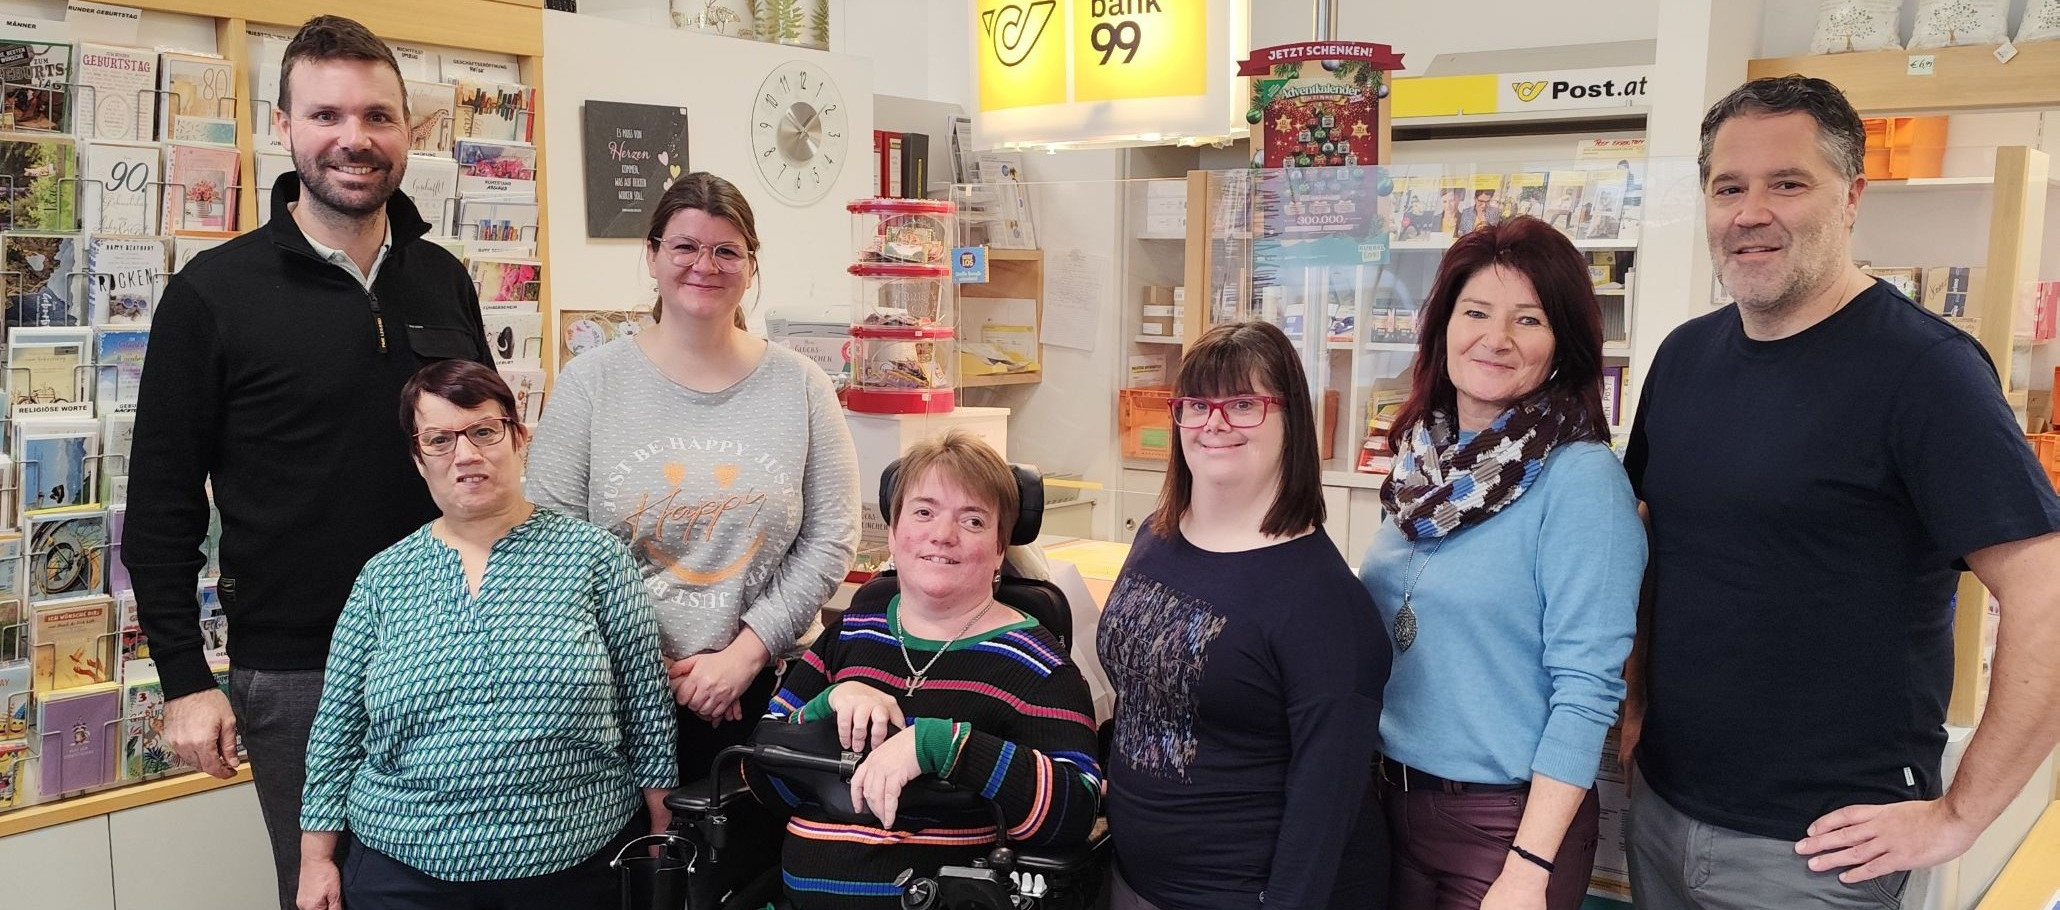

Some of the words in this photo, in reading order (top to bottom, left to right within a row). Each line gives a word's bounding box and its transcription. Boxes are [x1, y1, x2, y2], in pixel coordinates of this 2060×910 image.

[68, 5, 95, 14] RUNDER
[96, 9, 138, 20] GEBURTSTAG
[1091, 0, 1162, 18] bank
[6, 20, 37, 30] MÄNNER
[1090, 20, 1142, 66] 99
[1267, 47, 1303, 61] JETZT
[1305, 45, 1374, 59] SCHENKEN!
[82, 54, 151, 73] GEBURTSTAG
[203, 68, 228, 102] 80
[1282, 83, 1361, 99] Adventkalender
[1551, 76, 1648, 100] Post.at
[616, 128, 622, 138] ES
[608, 140, 651, 161] Herzen
[18, 406, 59, 414] RELIGIÖSE
[61, 404, 88, 412] WORTE
[603, 459, 633, 513] JUST
[632, 440, 665, 463] BE
[667, 436, 752, 457] HAPPY
[623, 486, 768, 548] Happy
[138, 693, 147, 702] 3
